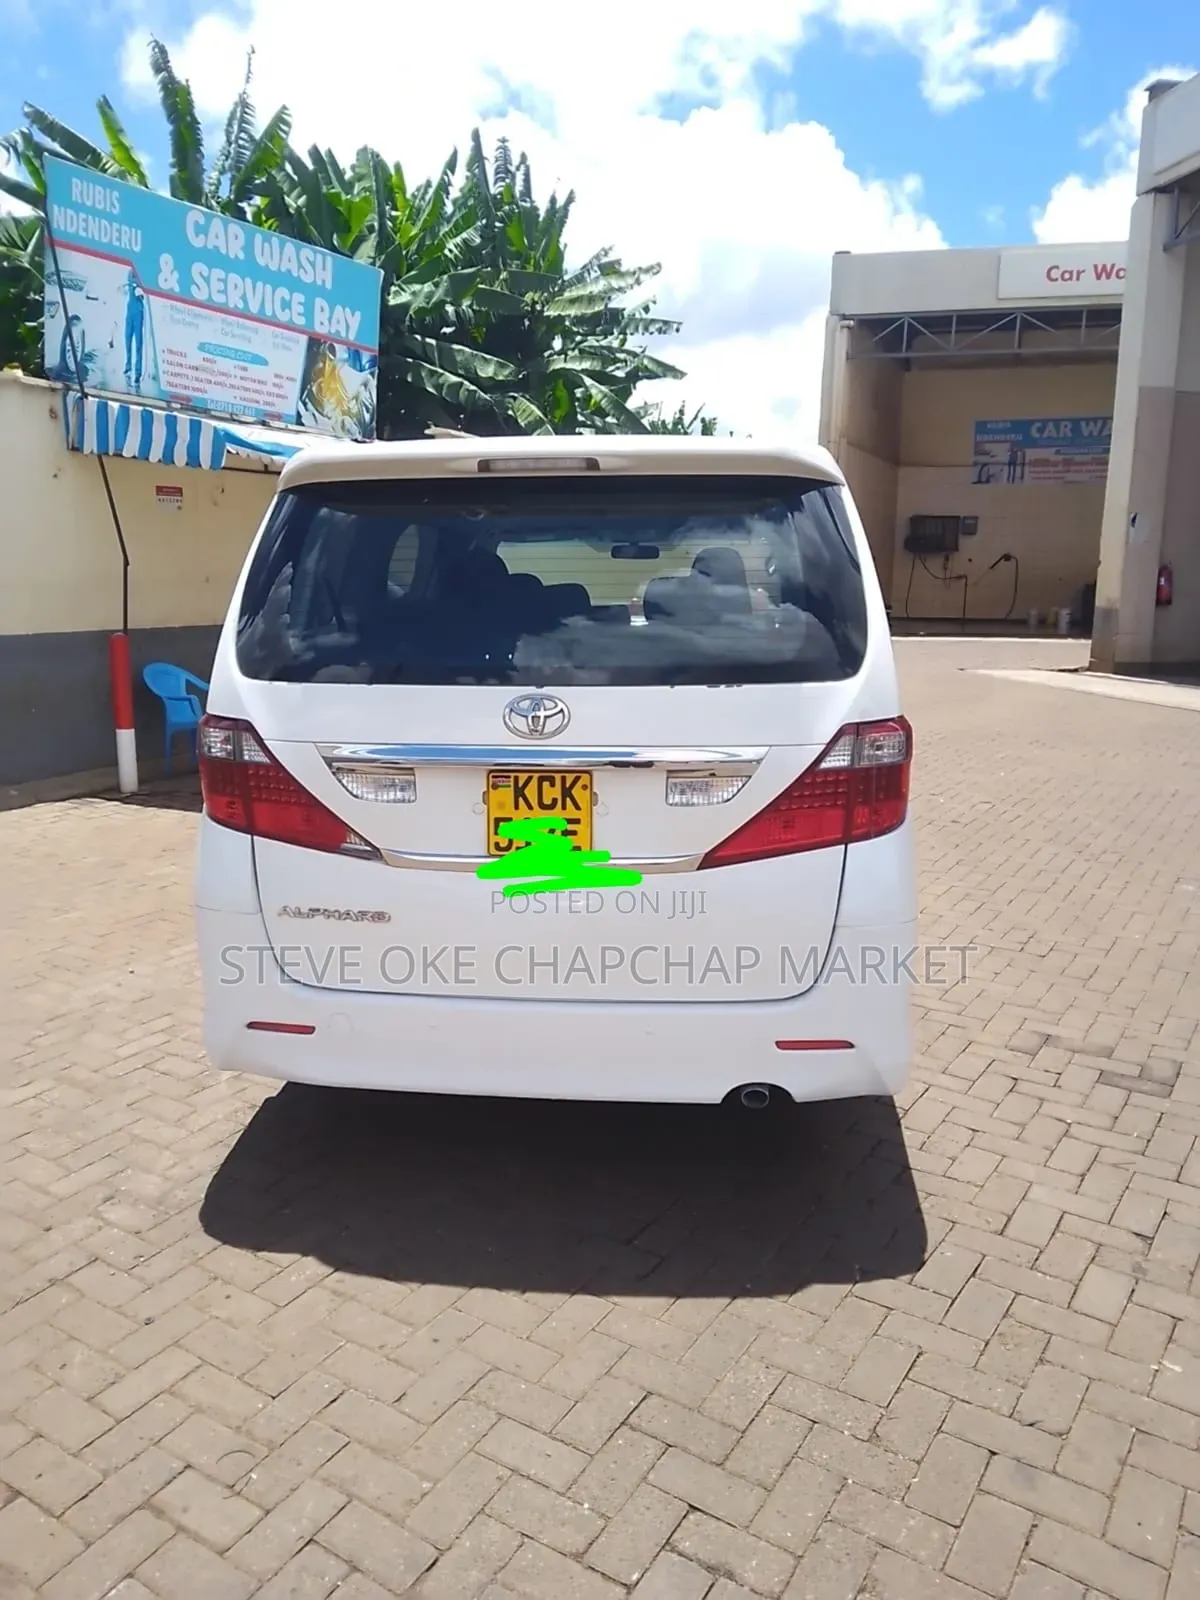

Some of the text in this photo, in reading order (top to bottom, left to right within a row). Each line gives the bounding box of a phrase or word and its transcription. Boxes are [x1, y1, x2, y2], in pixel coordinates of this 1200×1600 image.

[72, 177, 120, 215] RUBIS
[53, 204, 142, 253] NDENDERU
[186, 209, 333, 289] CAR WASH
[1046, 264, 1086, 282] Car
[158, 253, 361, 341] & SERVICE BAY
[1029, 421, 1073, 438] CAR
[513, 775, 582, 811] KCK
